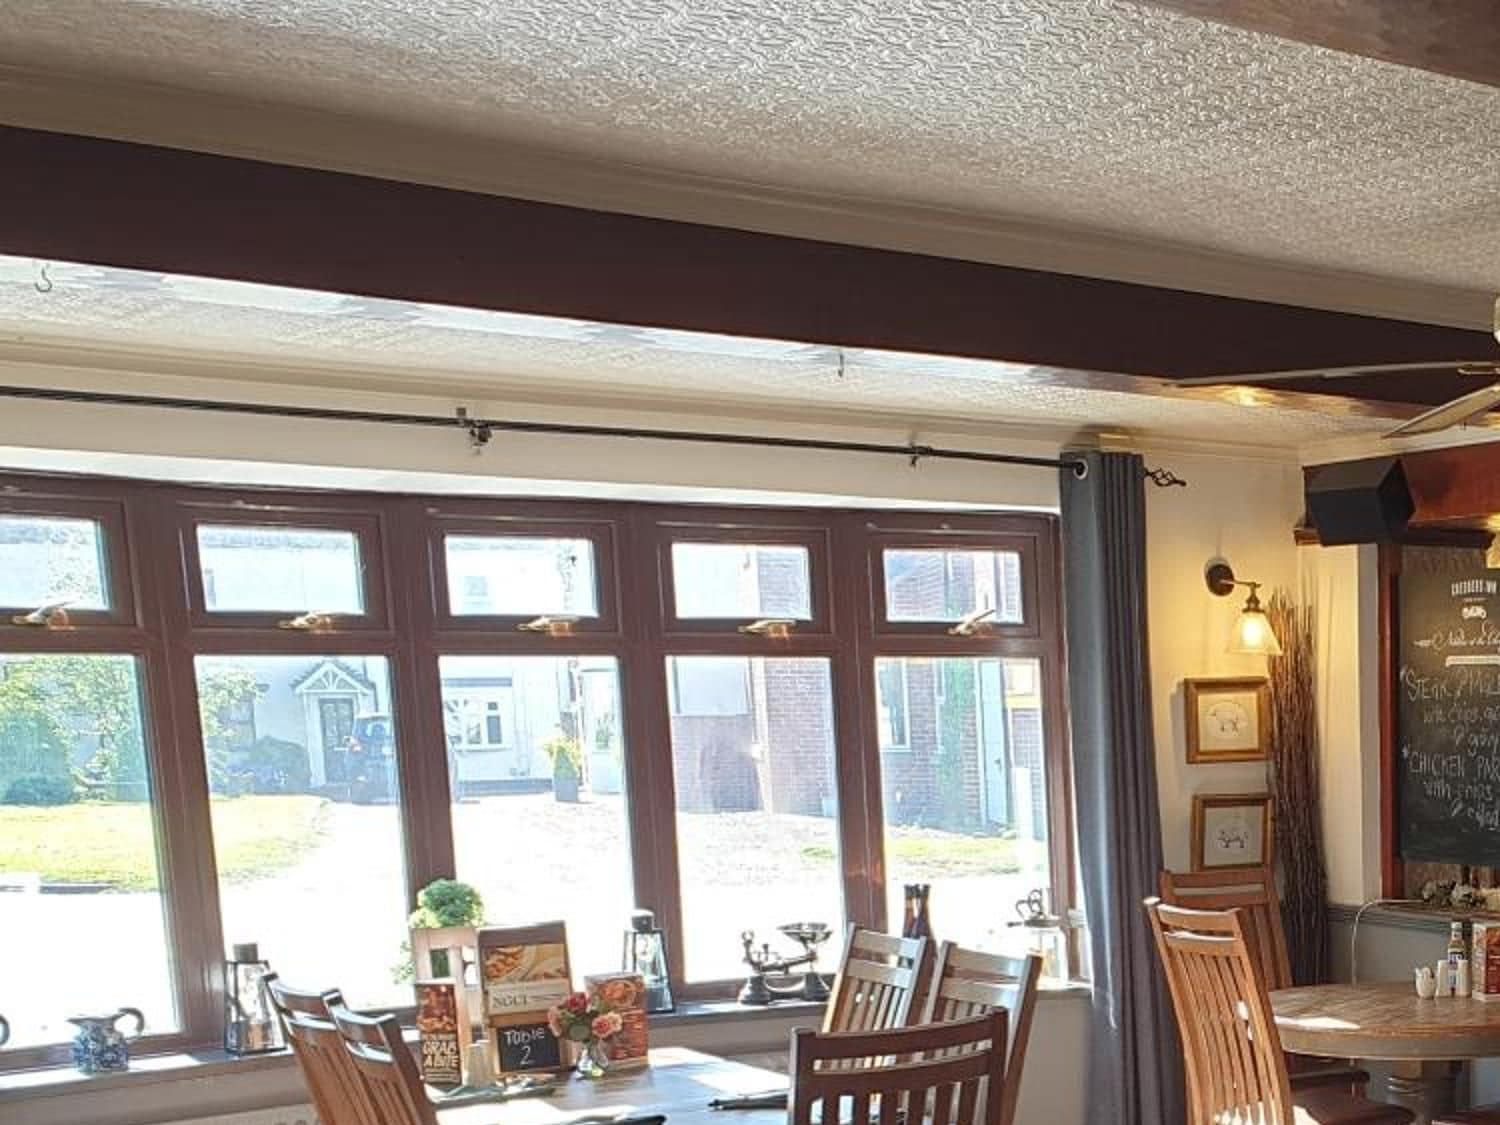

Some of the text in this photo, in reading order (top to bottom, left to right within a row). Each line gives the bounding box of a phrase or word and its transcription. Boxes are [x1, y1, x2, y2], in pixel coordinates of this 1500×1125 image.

[1409, 751, 1466, 777] CHICKEN
[504, 1027, 545, 1047] Table
[422, 1041, 458, 1055] GRAB
[519, 1045, 534, 1066] 2
